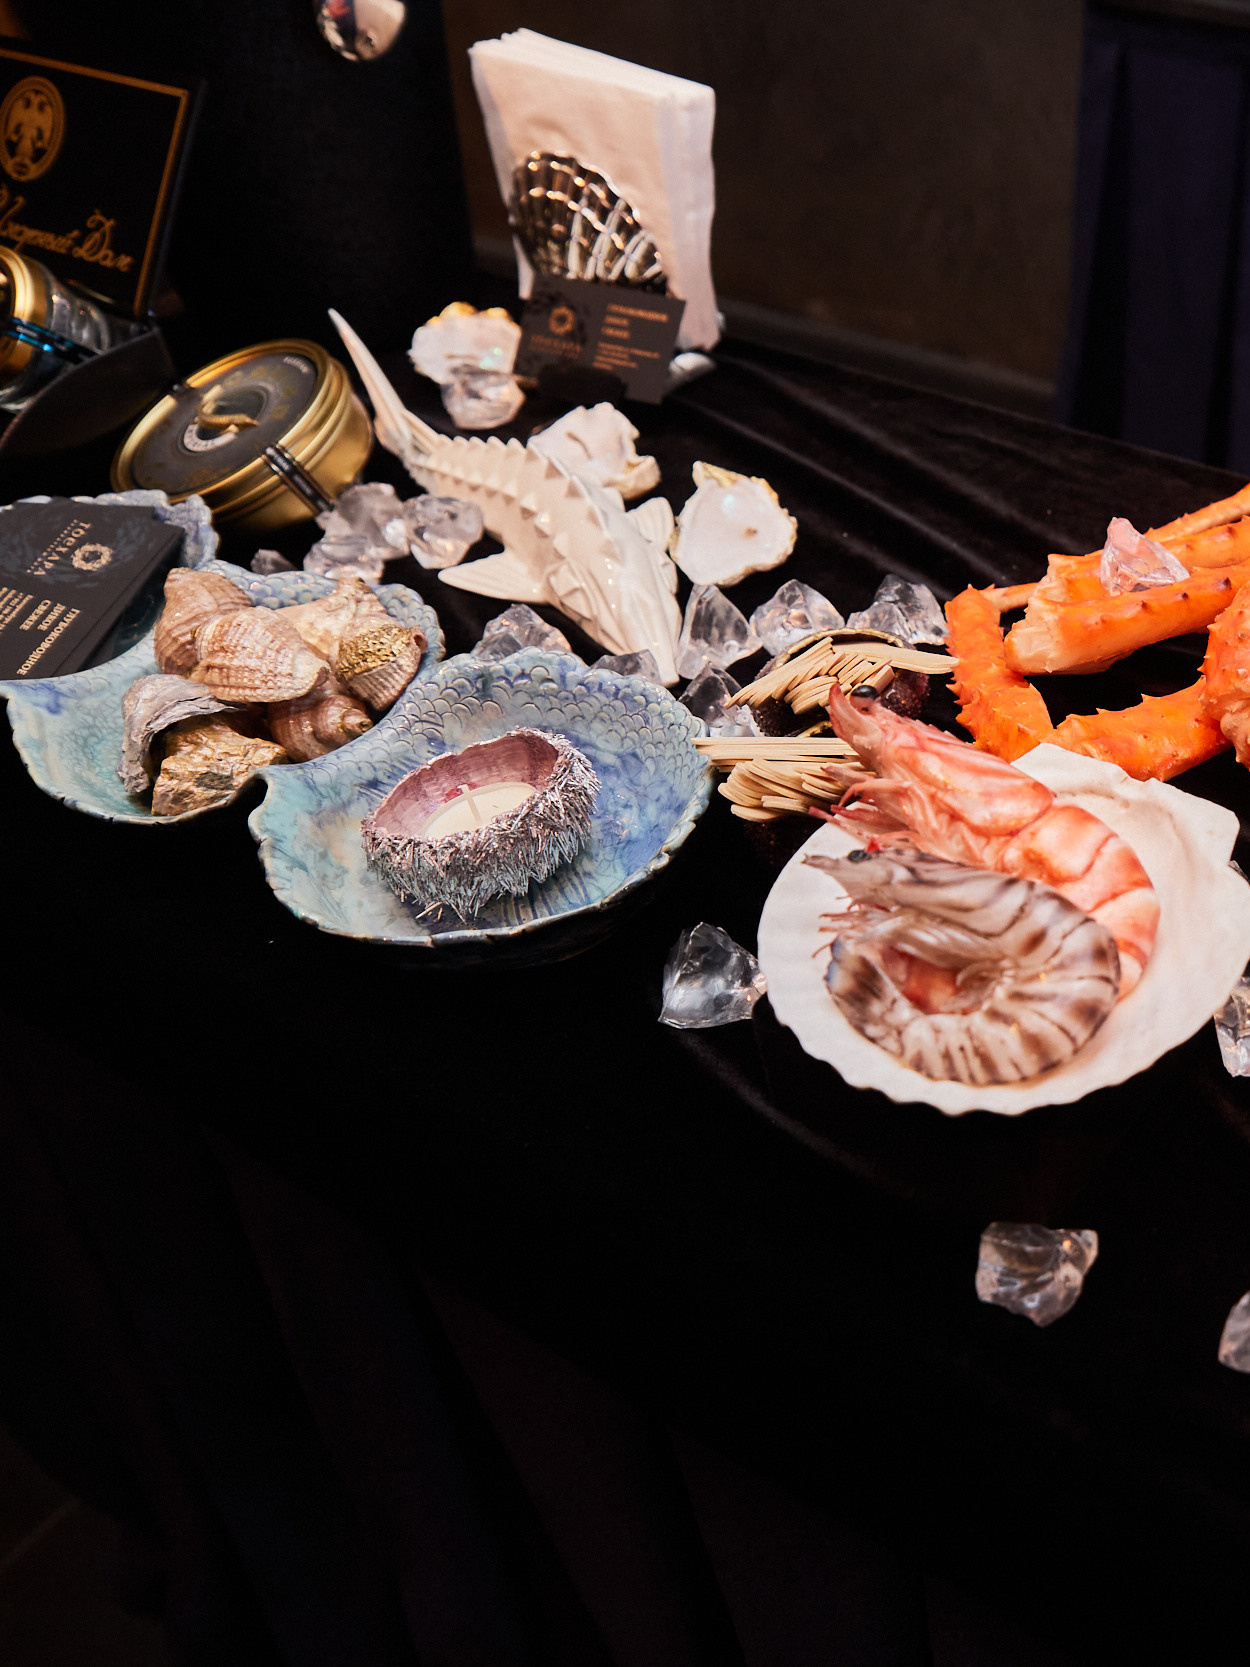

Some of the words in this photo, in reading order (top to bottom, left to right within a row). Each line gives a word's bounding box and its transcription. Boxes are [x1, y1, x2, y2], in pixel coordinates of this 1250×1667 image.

[19, 599, 52, 631] СВЕЖЕЕ
[37, 602, 67, 631] ДИКОЕ
[16, 607, 81, 676] ГЛУБОКОВОДНОЕ
